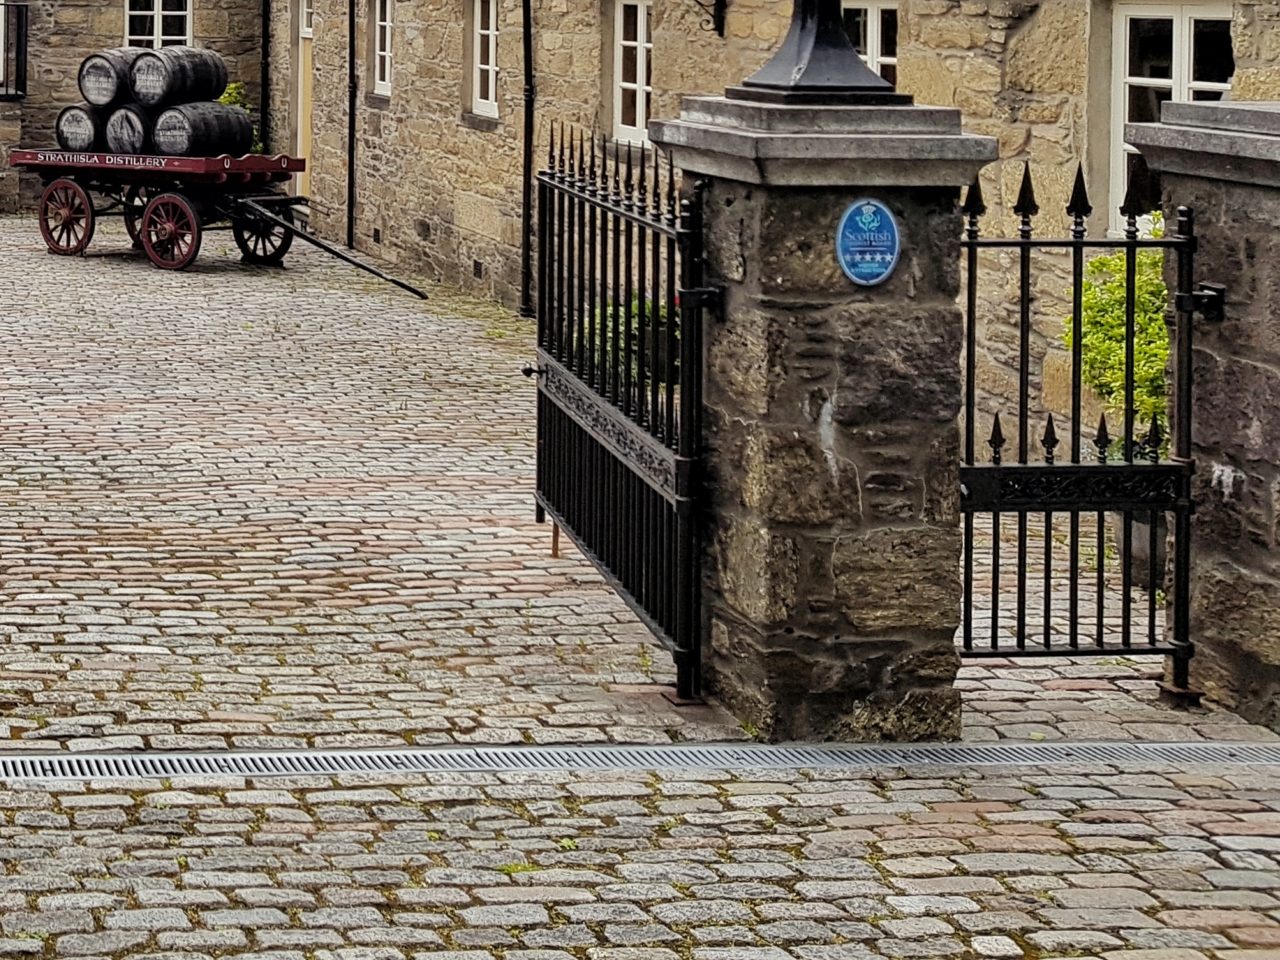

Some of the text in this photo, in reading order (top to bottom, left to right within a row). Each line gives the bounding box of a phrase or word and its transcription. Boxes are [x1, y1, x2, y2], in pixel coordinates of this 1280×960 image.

[37, 152, 168, 167] STRATHISLA DISTILLERY
[844, 228, 892, 241] Scottish
